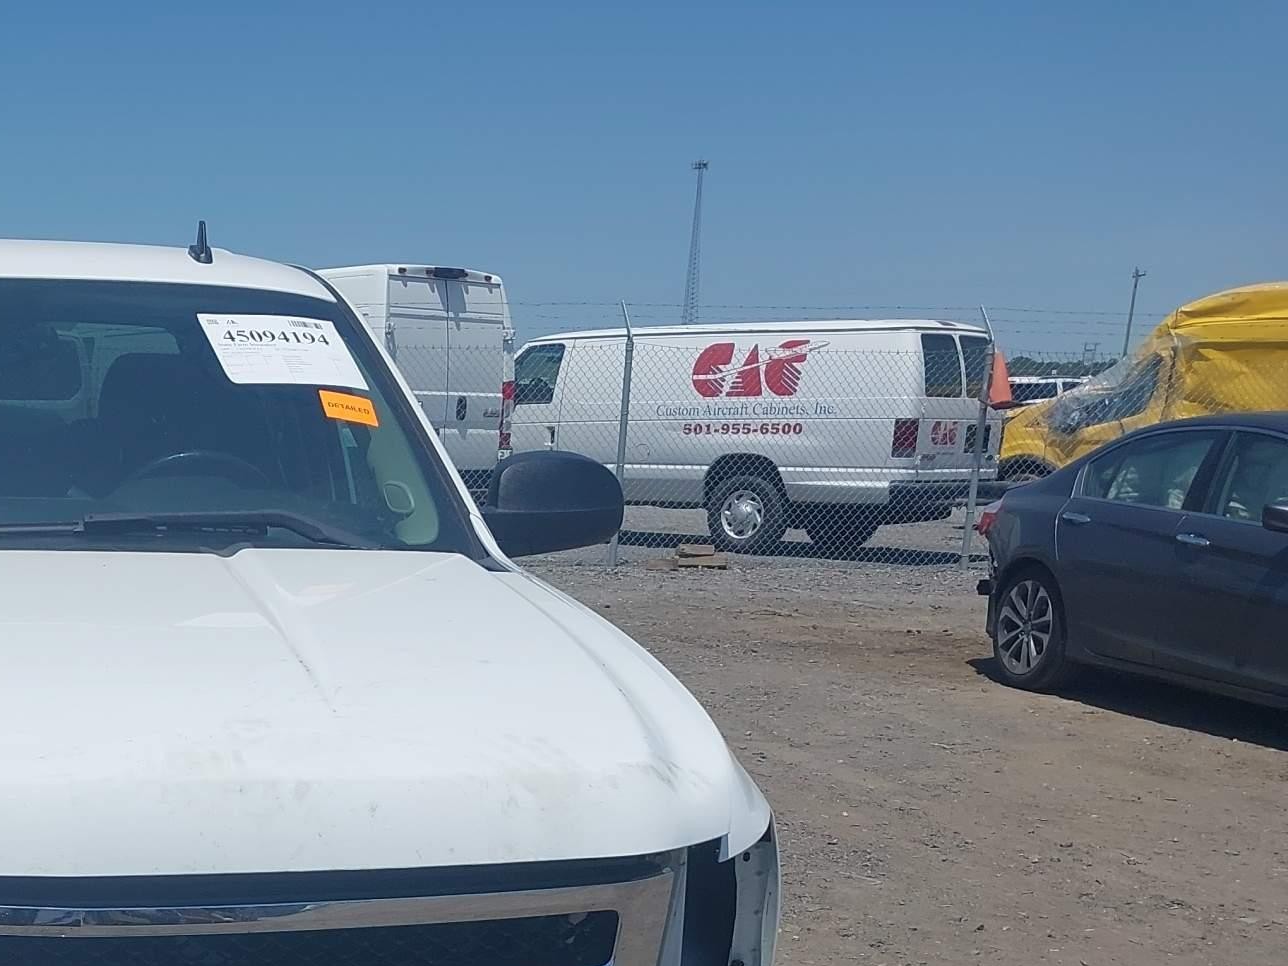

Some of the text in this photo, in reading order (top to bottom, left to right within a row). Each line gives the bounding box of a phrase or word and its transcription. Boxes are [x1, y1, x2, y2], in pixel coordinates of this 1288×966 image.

[223, 330, 330, 346] 45094194
[327, 402, 370, 415] DETAILED
[656, 402, 839, 417] Custom Aircraft Cabinets, Inc.
[682, 423, 803, 436] 501-955-6500
